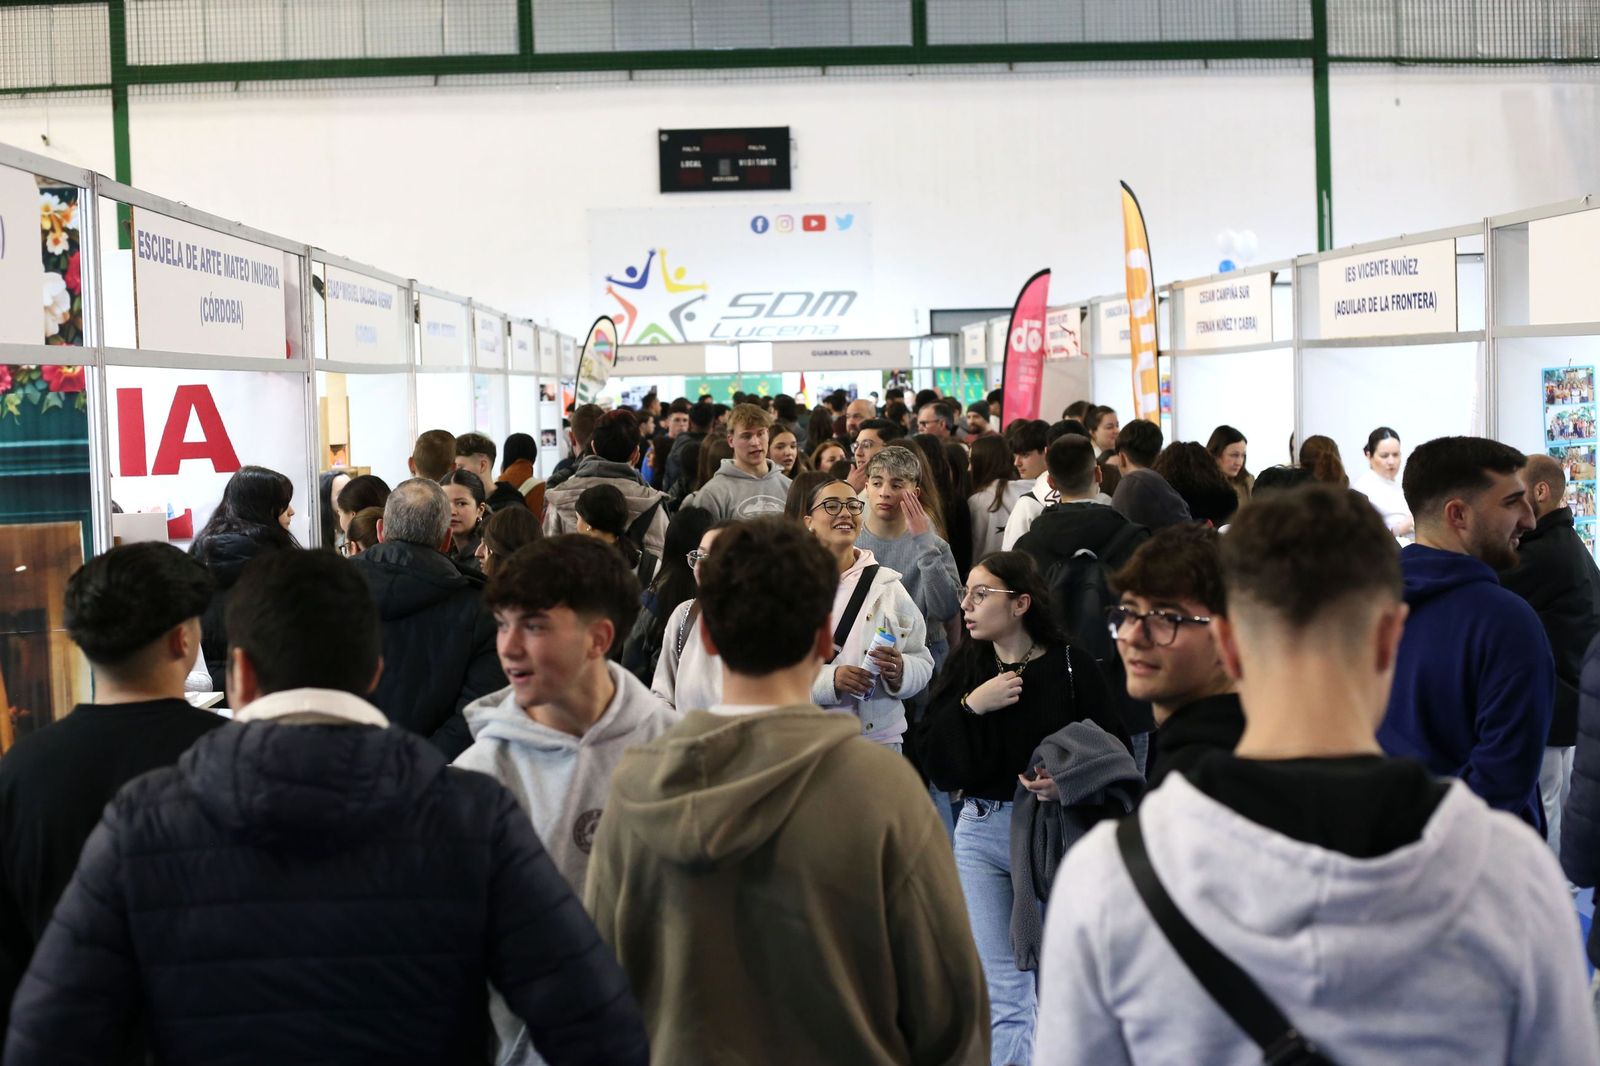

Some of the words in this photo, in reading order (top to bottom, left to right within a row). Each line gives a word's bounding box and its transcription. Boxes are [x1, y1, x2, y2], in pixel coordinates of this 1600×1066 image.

[680, 159, 702, 168] LOCAL
[738, 158, 777, 167] VISITANTE
[137, 230, 184, 268] ESCUELA
[185, 243, 198, 271] DE
[199, 247, 222, 276] ARTE
[223, 252, 250, 282] MATEO
[251, 259, 280, 289] INURRIA
[1345, 266, 1356, 283] IES
[1358, 258, 1389, 279] VICENTE
[720, 289, 858, 320] SDM
[1239, 284, 1250, 299] SUR
[1335, 297, 1366, 320] (AGUILAR
[1368, 296, 1378, 313] DE
[1379, 295, 1389, 312] LA
[1391, 290, 1437, 313] FRONTERA)
[200, 292, 244, 330] (CÓRDOBA)
[811, 349, 848, 357] GUARDIA
[111, 384, 241, 477] IA
